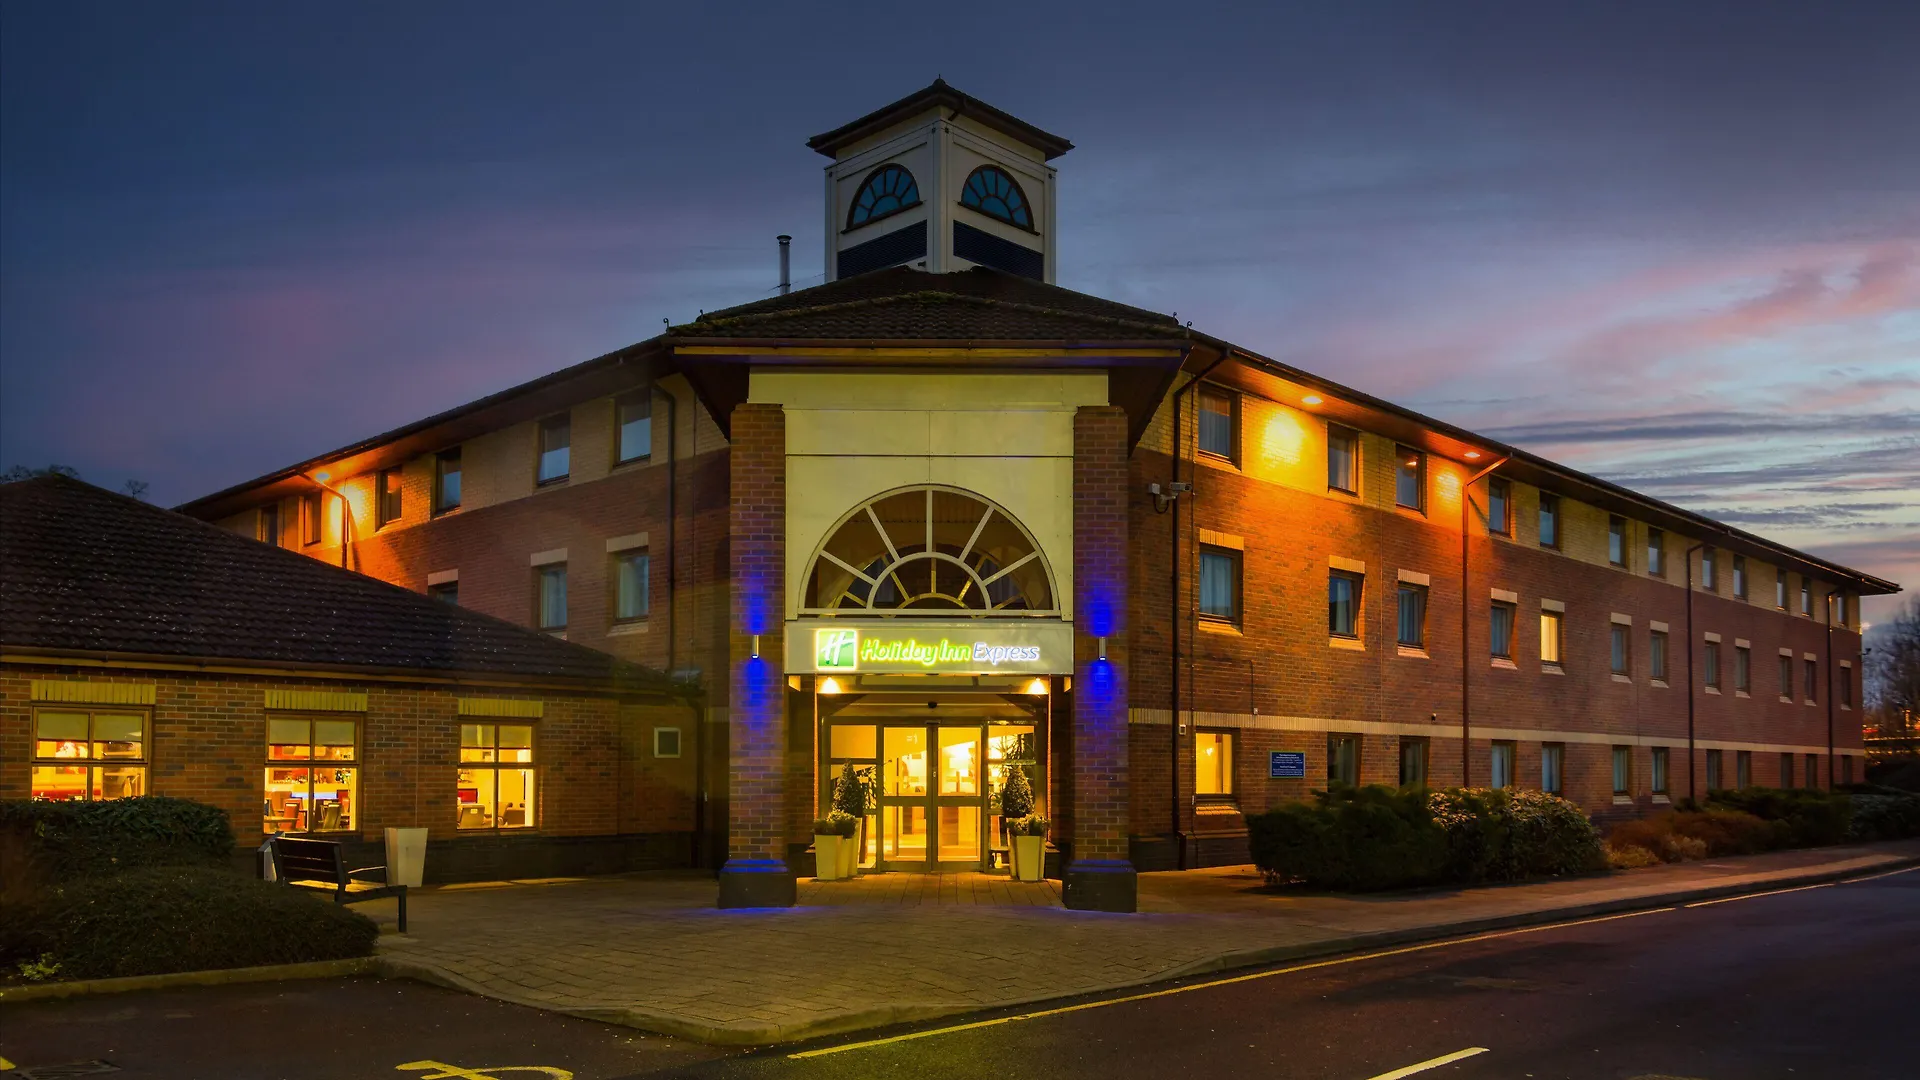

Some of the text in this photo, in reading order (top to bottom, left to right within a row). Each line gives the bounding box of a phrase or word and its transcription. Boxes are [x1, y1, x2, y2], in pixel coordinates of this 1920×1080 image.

[862, 638, 1039, 665] Holiday Inn Express
